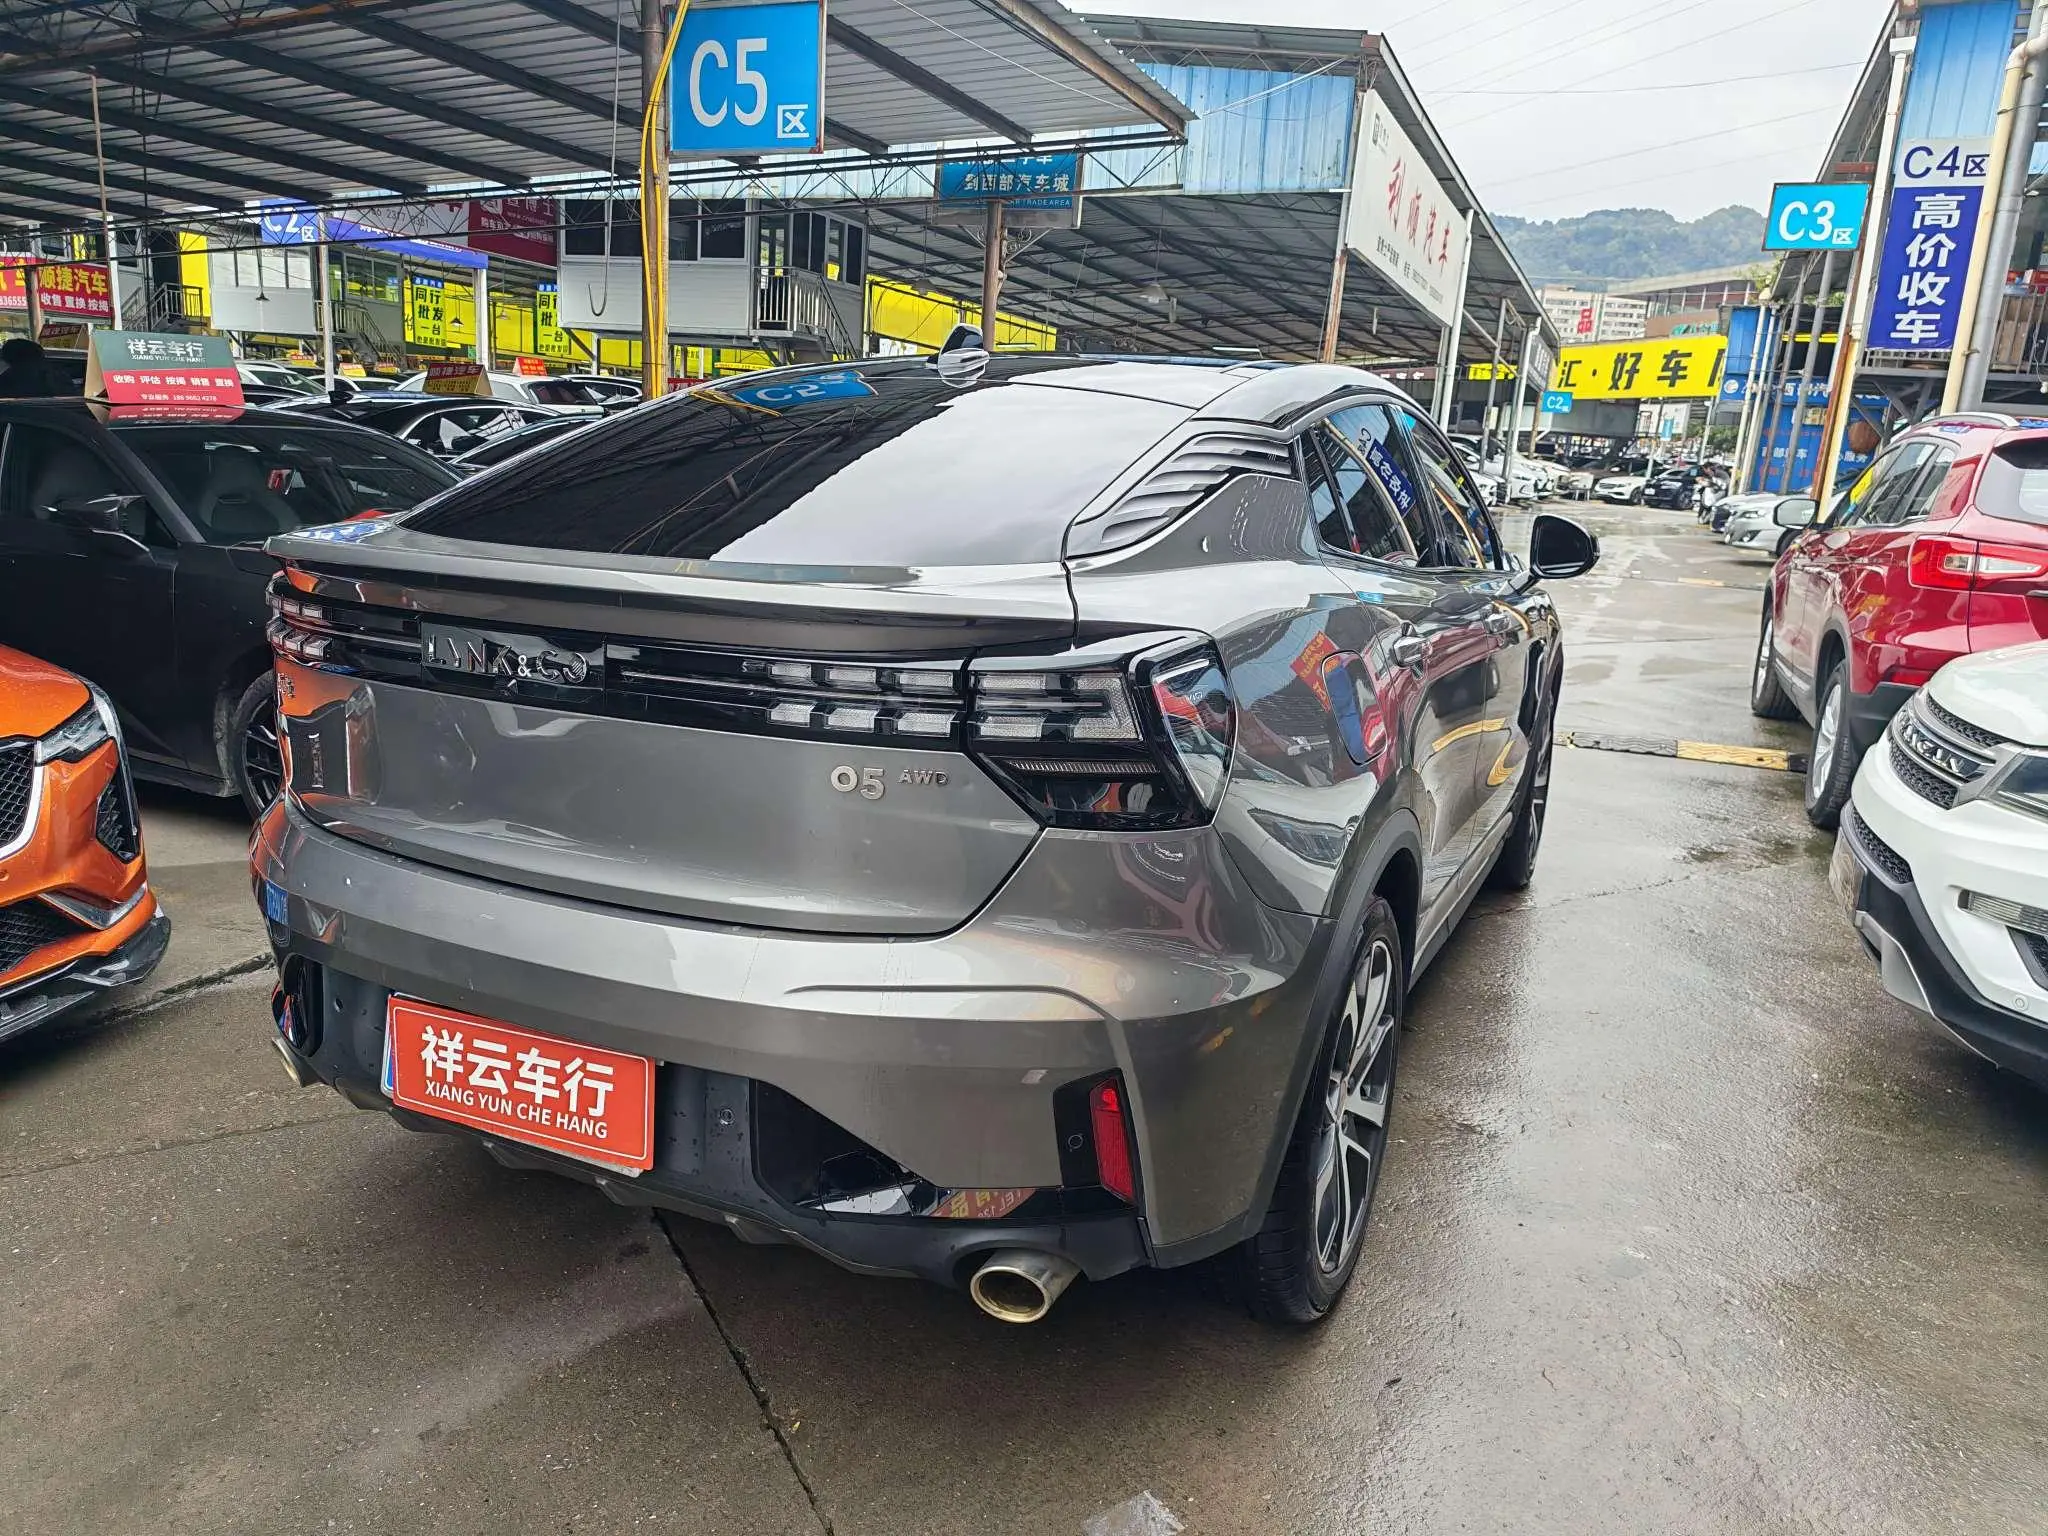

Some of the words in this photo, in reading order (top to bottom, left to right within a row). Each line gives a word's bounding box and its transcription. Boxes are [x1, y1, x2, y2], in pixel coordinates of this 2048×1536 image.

[1903, 146, 1990, 179] C4区
[964, 173, 1070, 192] 到西部汽车城
[1778, 200, 1854, 245] C3区
[40, 265, 108, 296] 顺捷汽车
[1890, 193, 1966, 344] 高价收车
[126, 338, 204, 358] 祥云车行
[1557, 348, 1726, 392] 汇·好车
[896, 768, 949, 786] AWD
[420, 1025, 615, 1118] 祥云车行
[425, 1079, 475, 1106] XIANG
[477, 1091, 513, 1117] YUN
[516, 1103, 552, 1126] CHE
[556, 1112, 609, 1140] HANG
